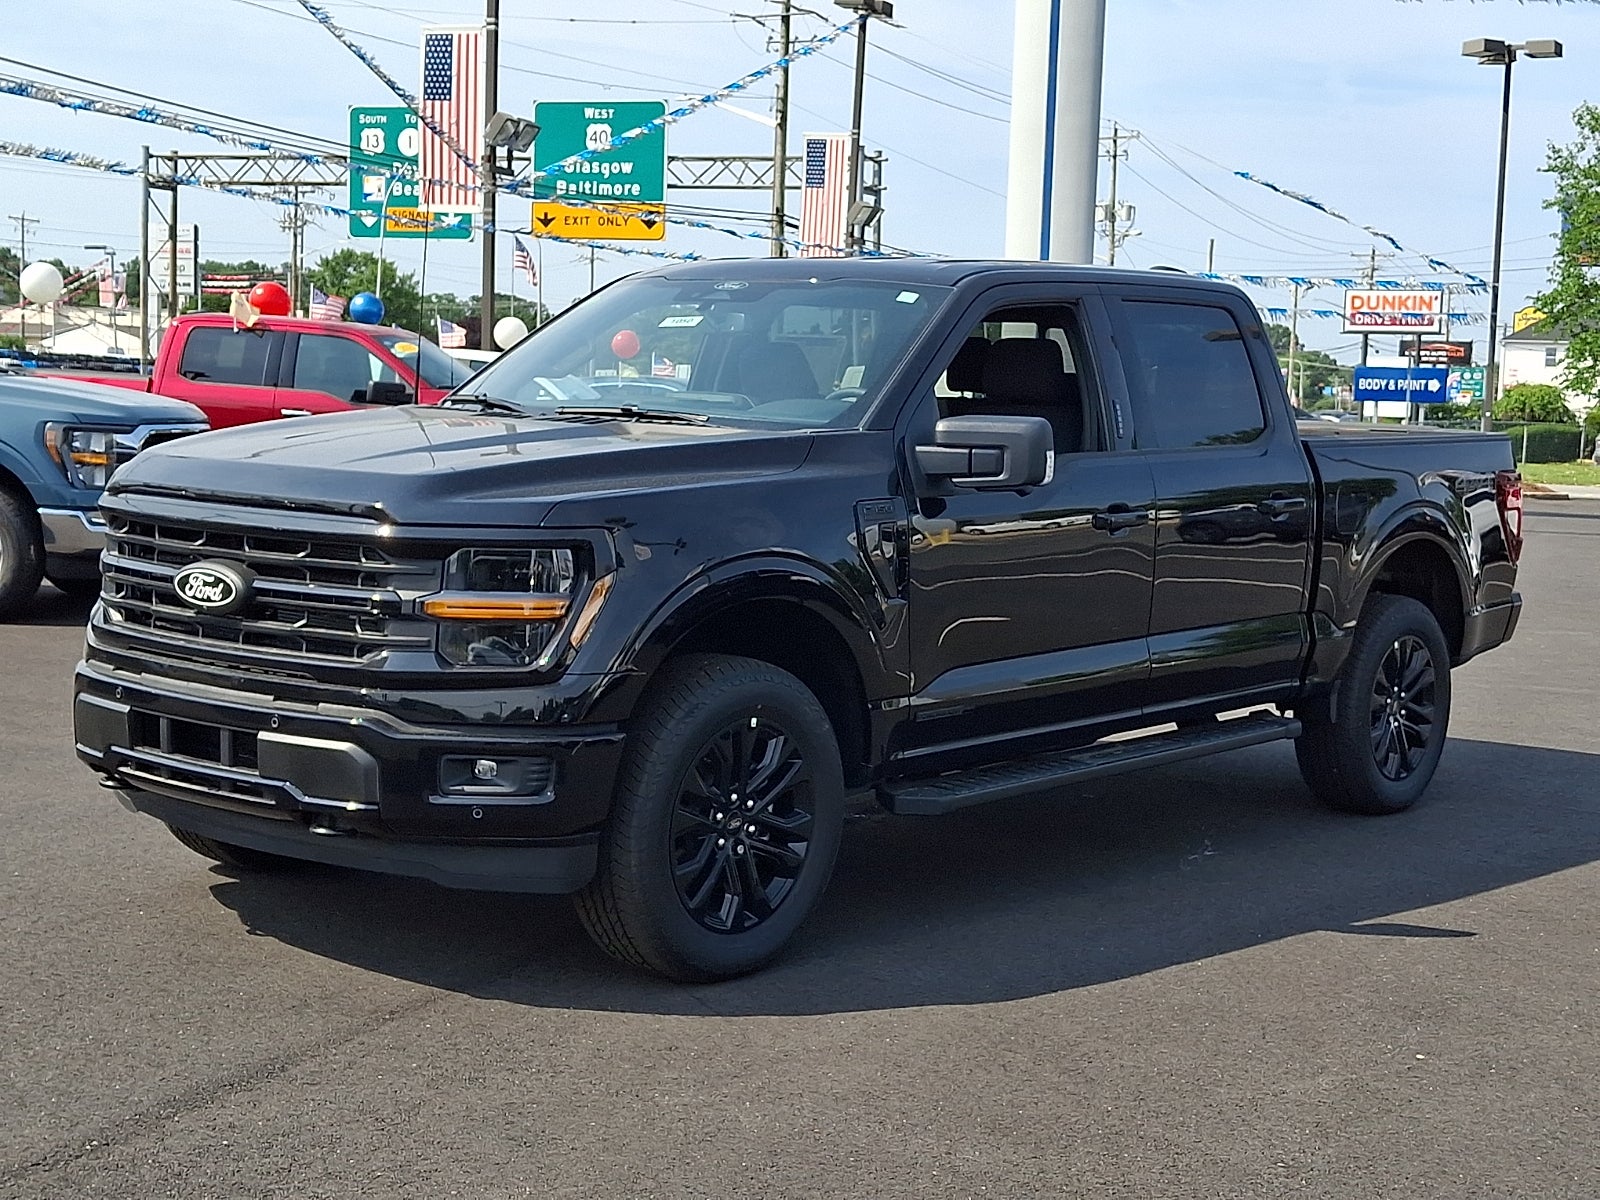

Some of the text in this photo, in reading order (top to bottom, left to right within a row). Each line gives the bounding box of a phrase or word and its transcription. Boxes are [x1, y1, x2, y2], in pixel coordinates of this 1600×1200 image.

[359, 114, 387, 123] SOUTH
[405, 114, 416, 123] TO
[584, 107, 615, 119] WEST
[366, 135, 379, 148] 13
[590, 130, 608, 145] 40
[564, 161, 633, 179] Glasgow
[557, 180, 641, 196] Baltimore
[564, 216, 630, 227] EXIT ONLY
[1351, 294, 1438, 312] DUNKIN'
[1359, 378, 1427, 391] BODY & PAINT
[185, 572, 224, 601] Ford
